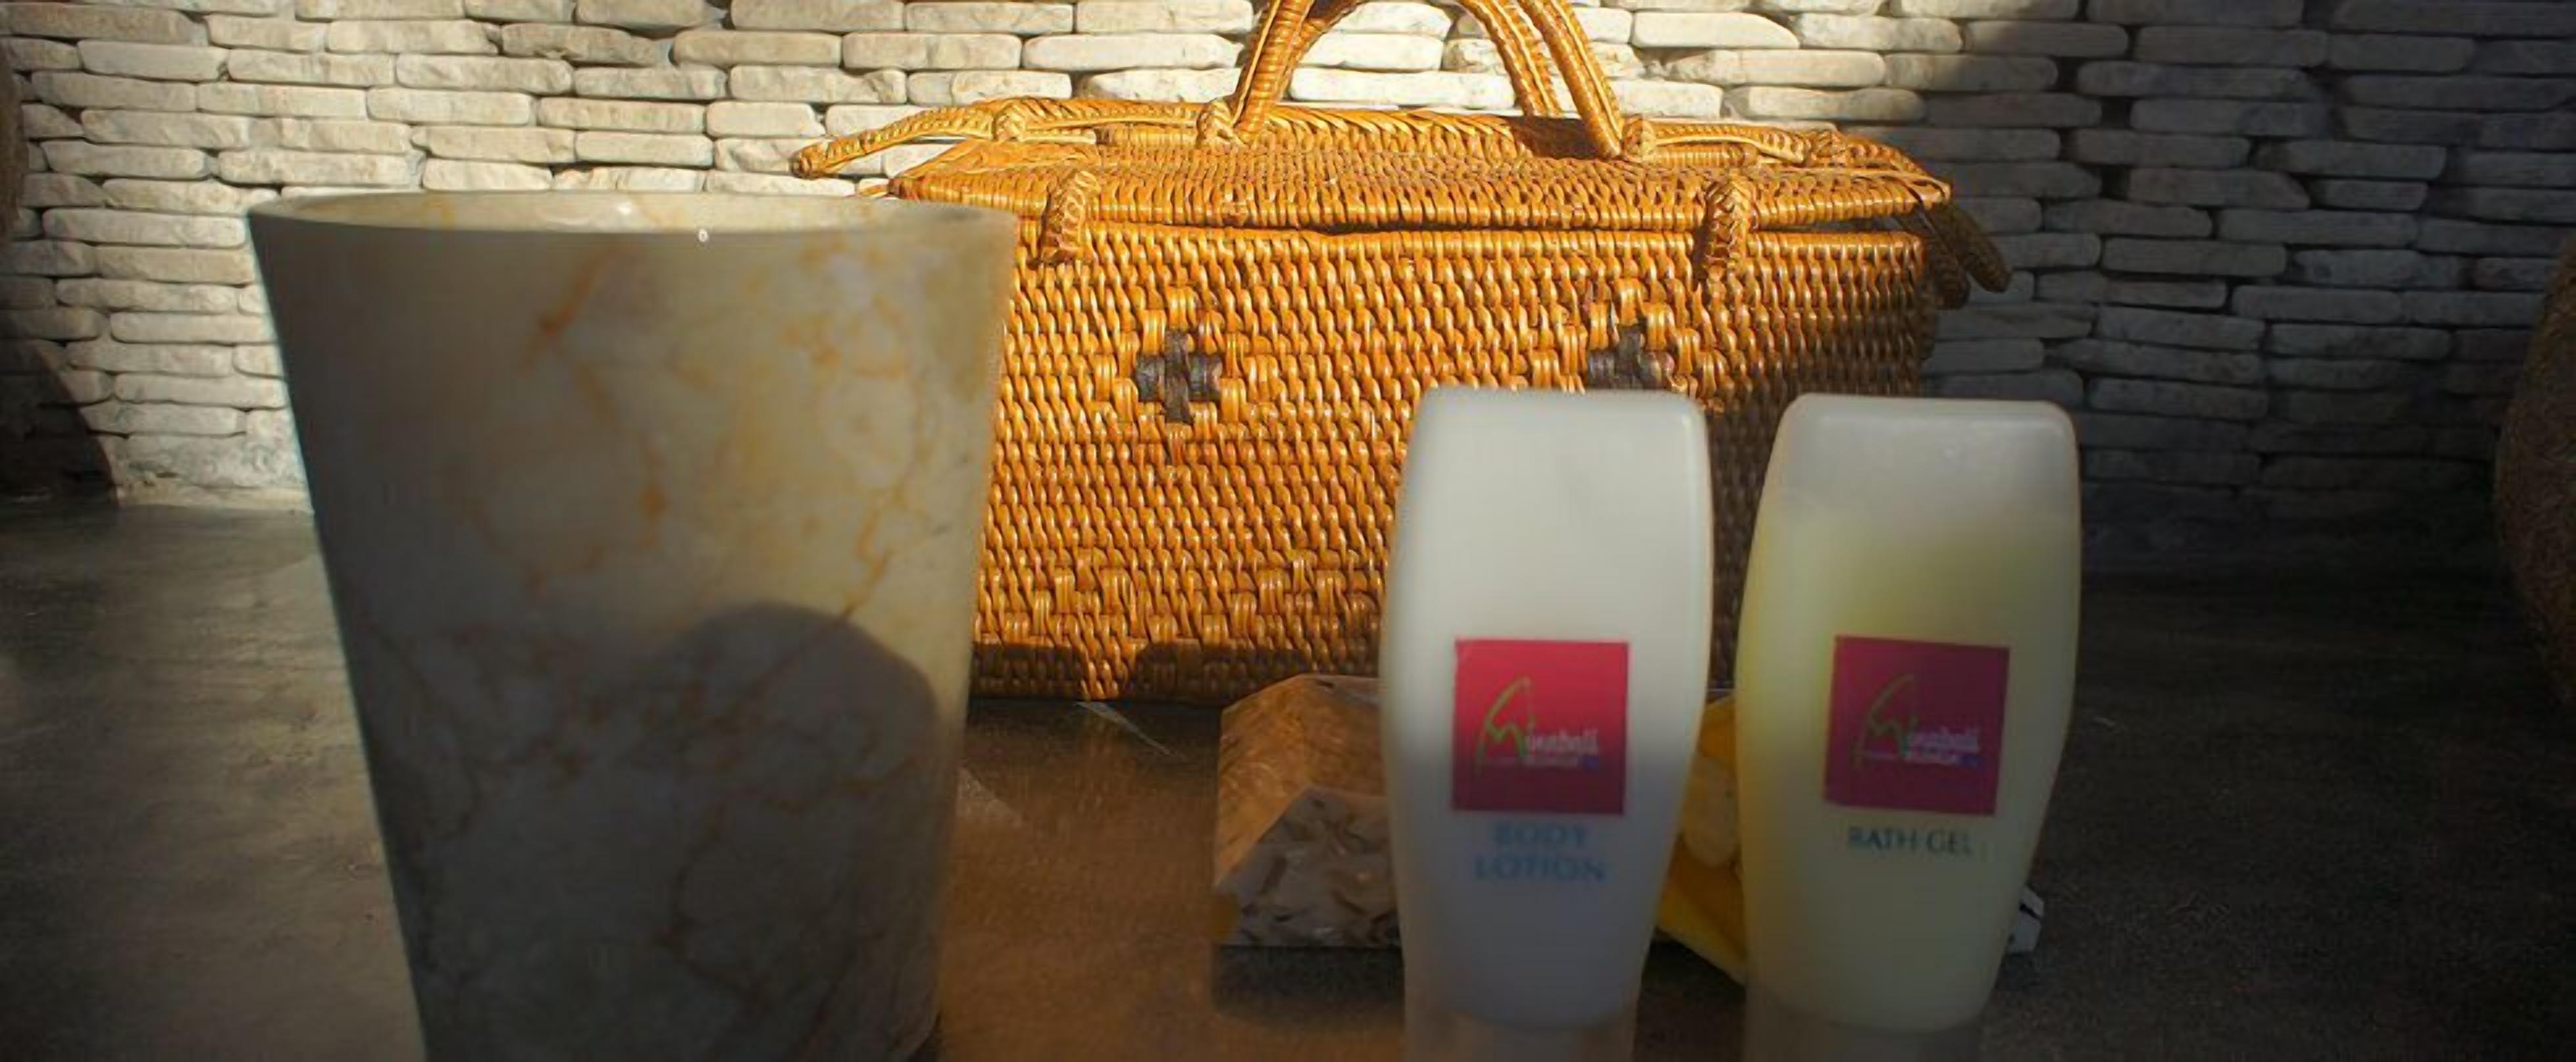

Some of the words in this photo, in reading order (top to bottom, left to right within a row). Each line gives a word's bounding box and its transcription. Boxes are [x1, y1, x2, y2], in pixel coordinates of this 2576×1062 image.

[1493, 824, 1589, 848] BODY
[1849, 828, 1918, 850] BATH
[1925, 830, 1974, 854] GEL
[1474, 855, 1609, 882] LOTION
